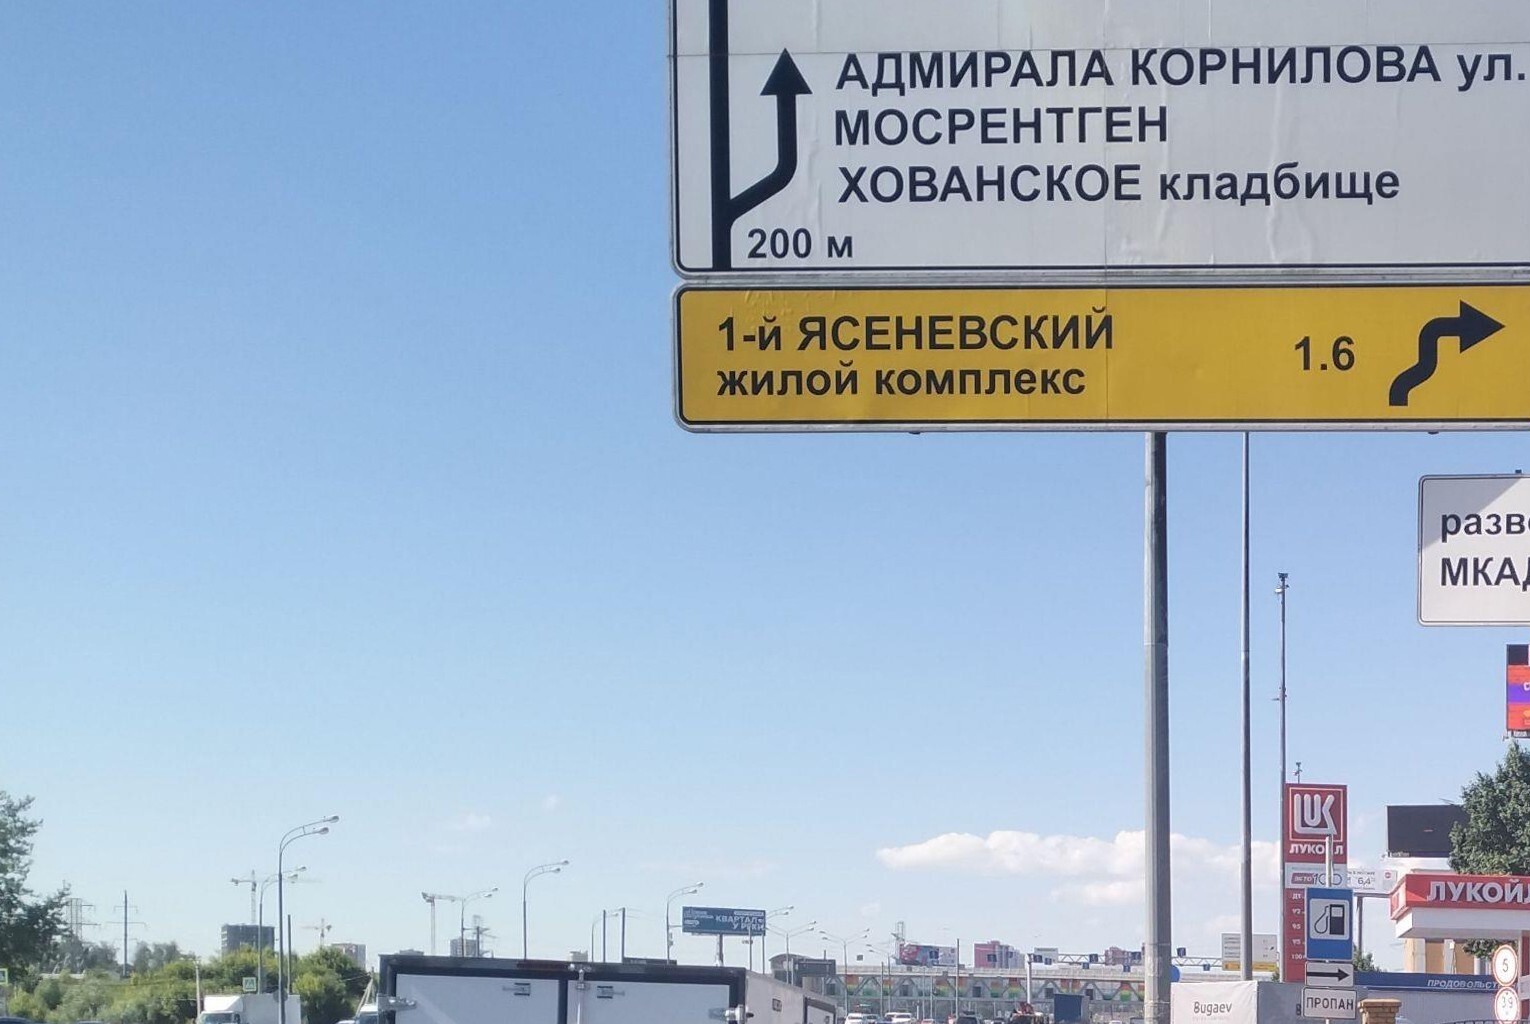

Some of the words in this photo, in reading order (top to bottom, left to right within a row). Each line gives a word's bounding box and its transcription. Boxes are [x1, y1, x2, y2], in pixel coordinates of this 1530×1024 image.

[836, 50, 1114, 97] АДМИРАЛА
[1132, 45, 1441, 85] КОРНИЛОВА
[1457, 54, 1525, 91] ул.
[836, 106, 1166, 145] МОСРЕНТГЕН
[839, 165, 1141, 202] ХОВАНСКОЕ
[1161, 162, 1399, 206] кладбище
[748, 228, 811, 258] 200
[828, 236, 852, 258] м
[719, 316, 781, 351] 1-й
[797, 307, 1112, 350] ЯСЕНЕВСКИЙ
[1295, 336, 1354, 371] 1.6
[717, 360, 857, 395] жилой
[876, 369, 1085, 395] комплекс
[1289, 844, 1344, 856] ЛУКОЛ
[1427, 979, 1500, 990] ПРОДОВОЛЬСТ
[1194, 1001, 1232, 1016] Bugaev
[1307, 997, 1353, 1010] ПРОПАН
